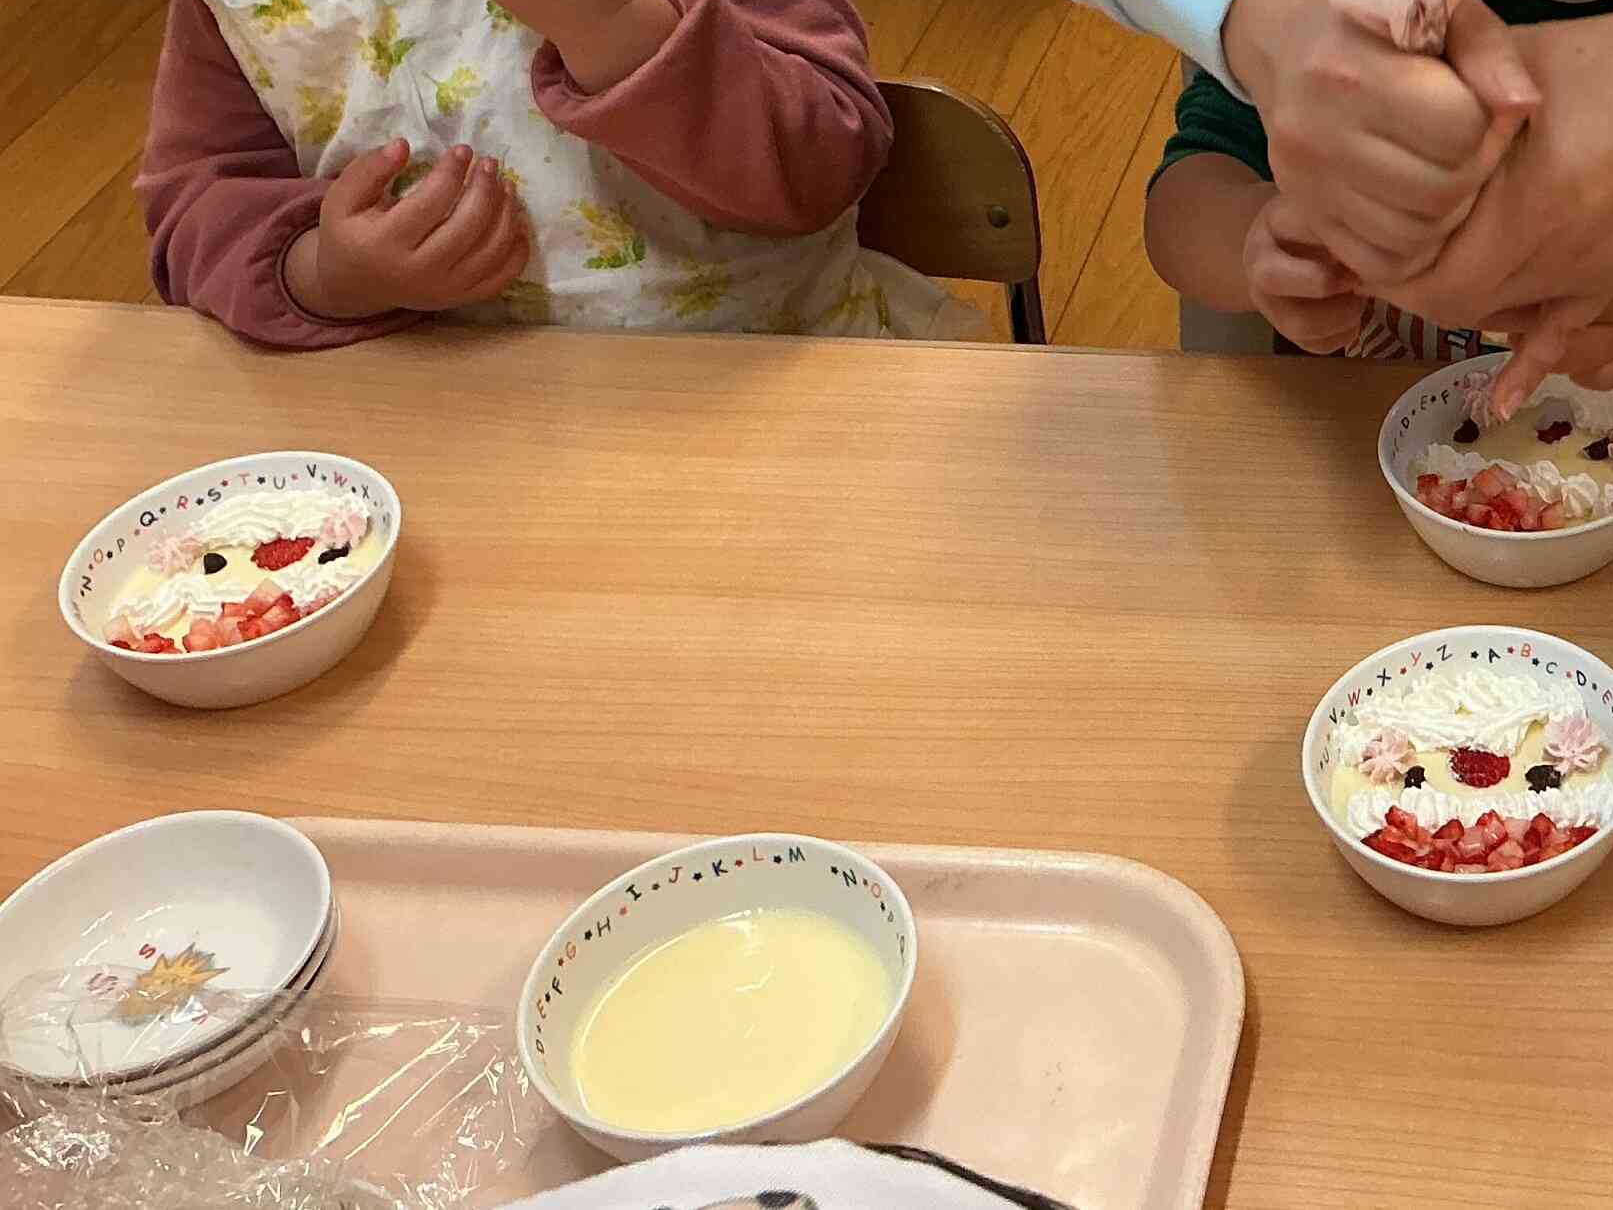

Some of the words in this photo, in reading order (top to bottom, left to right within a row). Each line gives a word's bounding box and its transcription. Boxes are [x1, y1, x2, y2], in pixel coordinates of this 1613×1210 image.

[1401, 417, 1410, 429] D
[1420, 395, 1428, 410] E
[1441, 389, 1450, 405] F
[116, 538, 125, 552] P
[140, 511, 158, 526] Q
[177, 495, 189, 510] R
[207, 488, 222, 502] S
[238, 473, 250, 486] T
[274, 477, 286, 490] U
[307, 464, 317, 478] V
[334, 471, 348, 486] W
[361, 484, 369, 499] X
[1329, 707, 1338, 724] V
[1348, 688, 1361, 707] W
[1376, 668, 1392, 687] X
[1411, 651, 1422, 667] Y
[1436, 644, 1453, 661] Z
[1488, 648, 1501, 663] A
[1520, 643, 1532, 658] B
[1546, 661, 1558, 674] C
[1576, 670, 1587, 686] D
[1602, 690, 1613, 705] E
[552, 976, 562, 995] F
[565, 942, 577, 960] G
[597, 917, 611, 937] H
[625, 884, 642, 901] I
[668, 866, 683, 884] J
[712, 859, 728, 877] K
[753, 846, 764, 862] L
[789, 846, 806, 863] M
[843, 869, 858, 886] N
[870, 882, 881, 898] O
